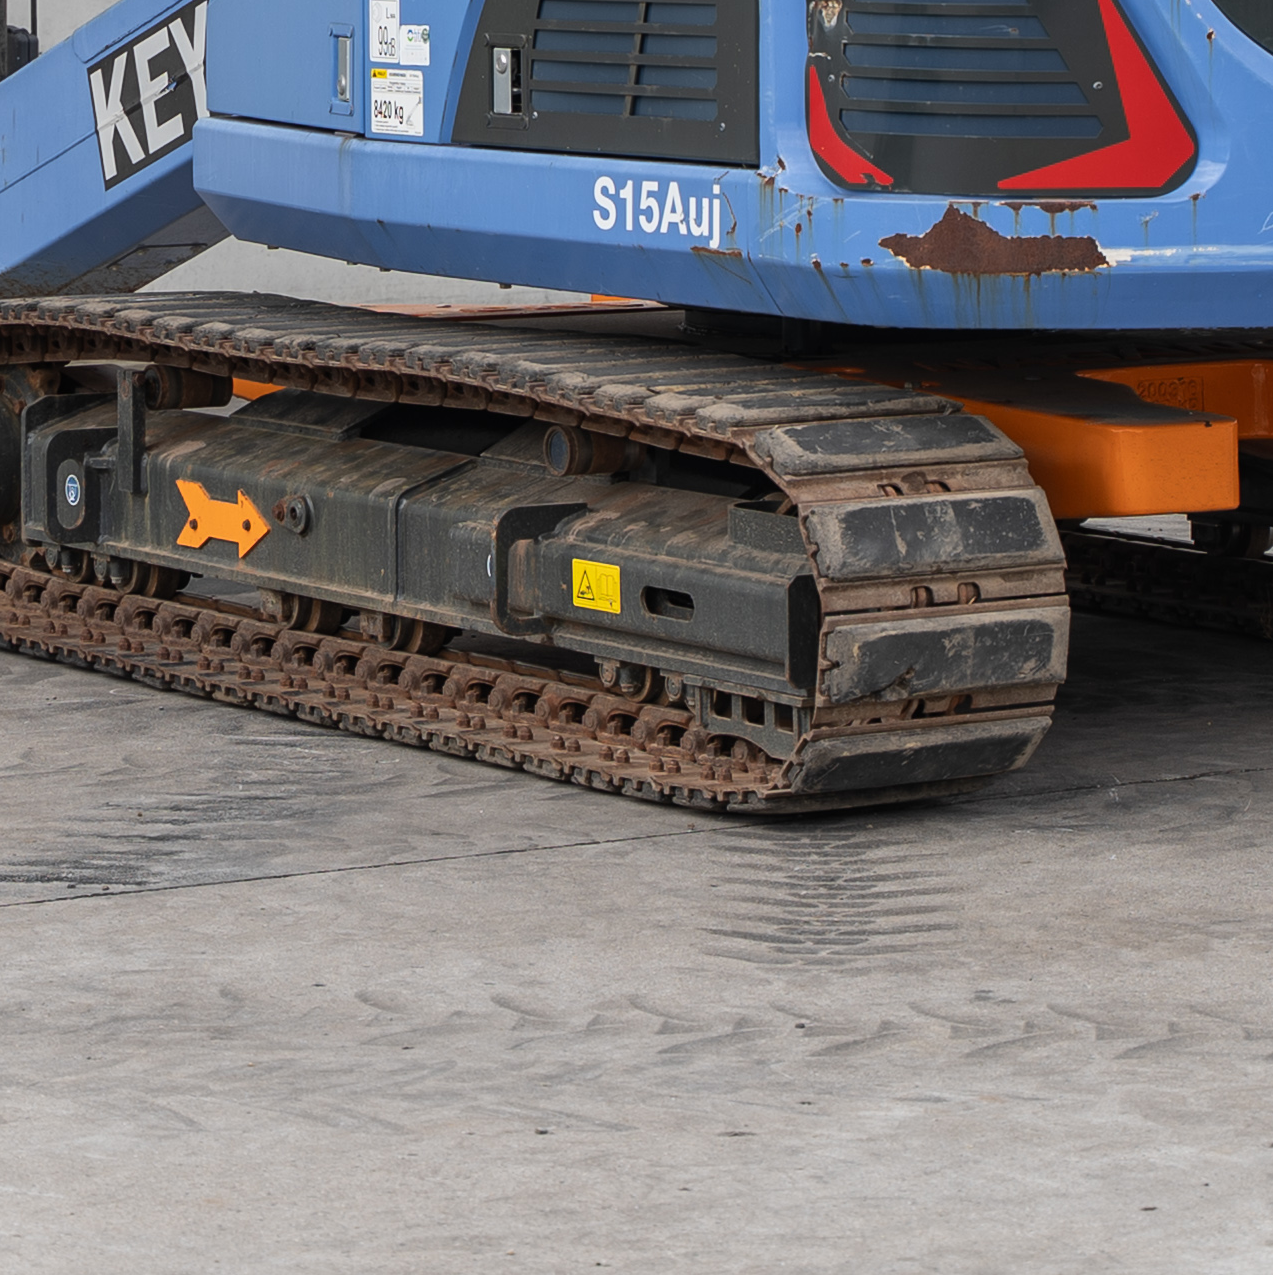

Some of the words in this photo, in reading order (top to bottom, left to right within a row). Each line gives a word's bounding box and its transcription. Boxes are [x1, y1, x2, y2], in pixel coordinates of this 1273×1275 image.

[373, 99, 393, 119] 8420
[393, 99, 404, 125] kg
[592, 175, 721, 250] S15Auj
